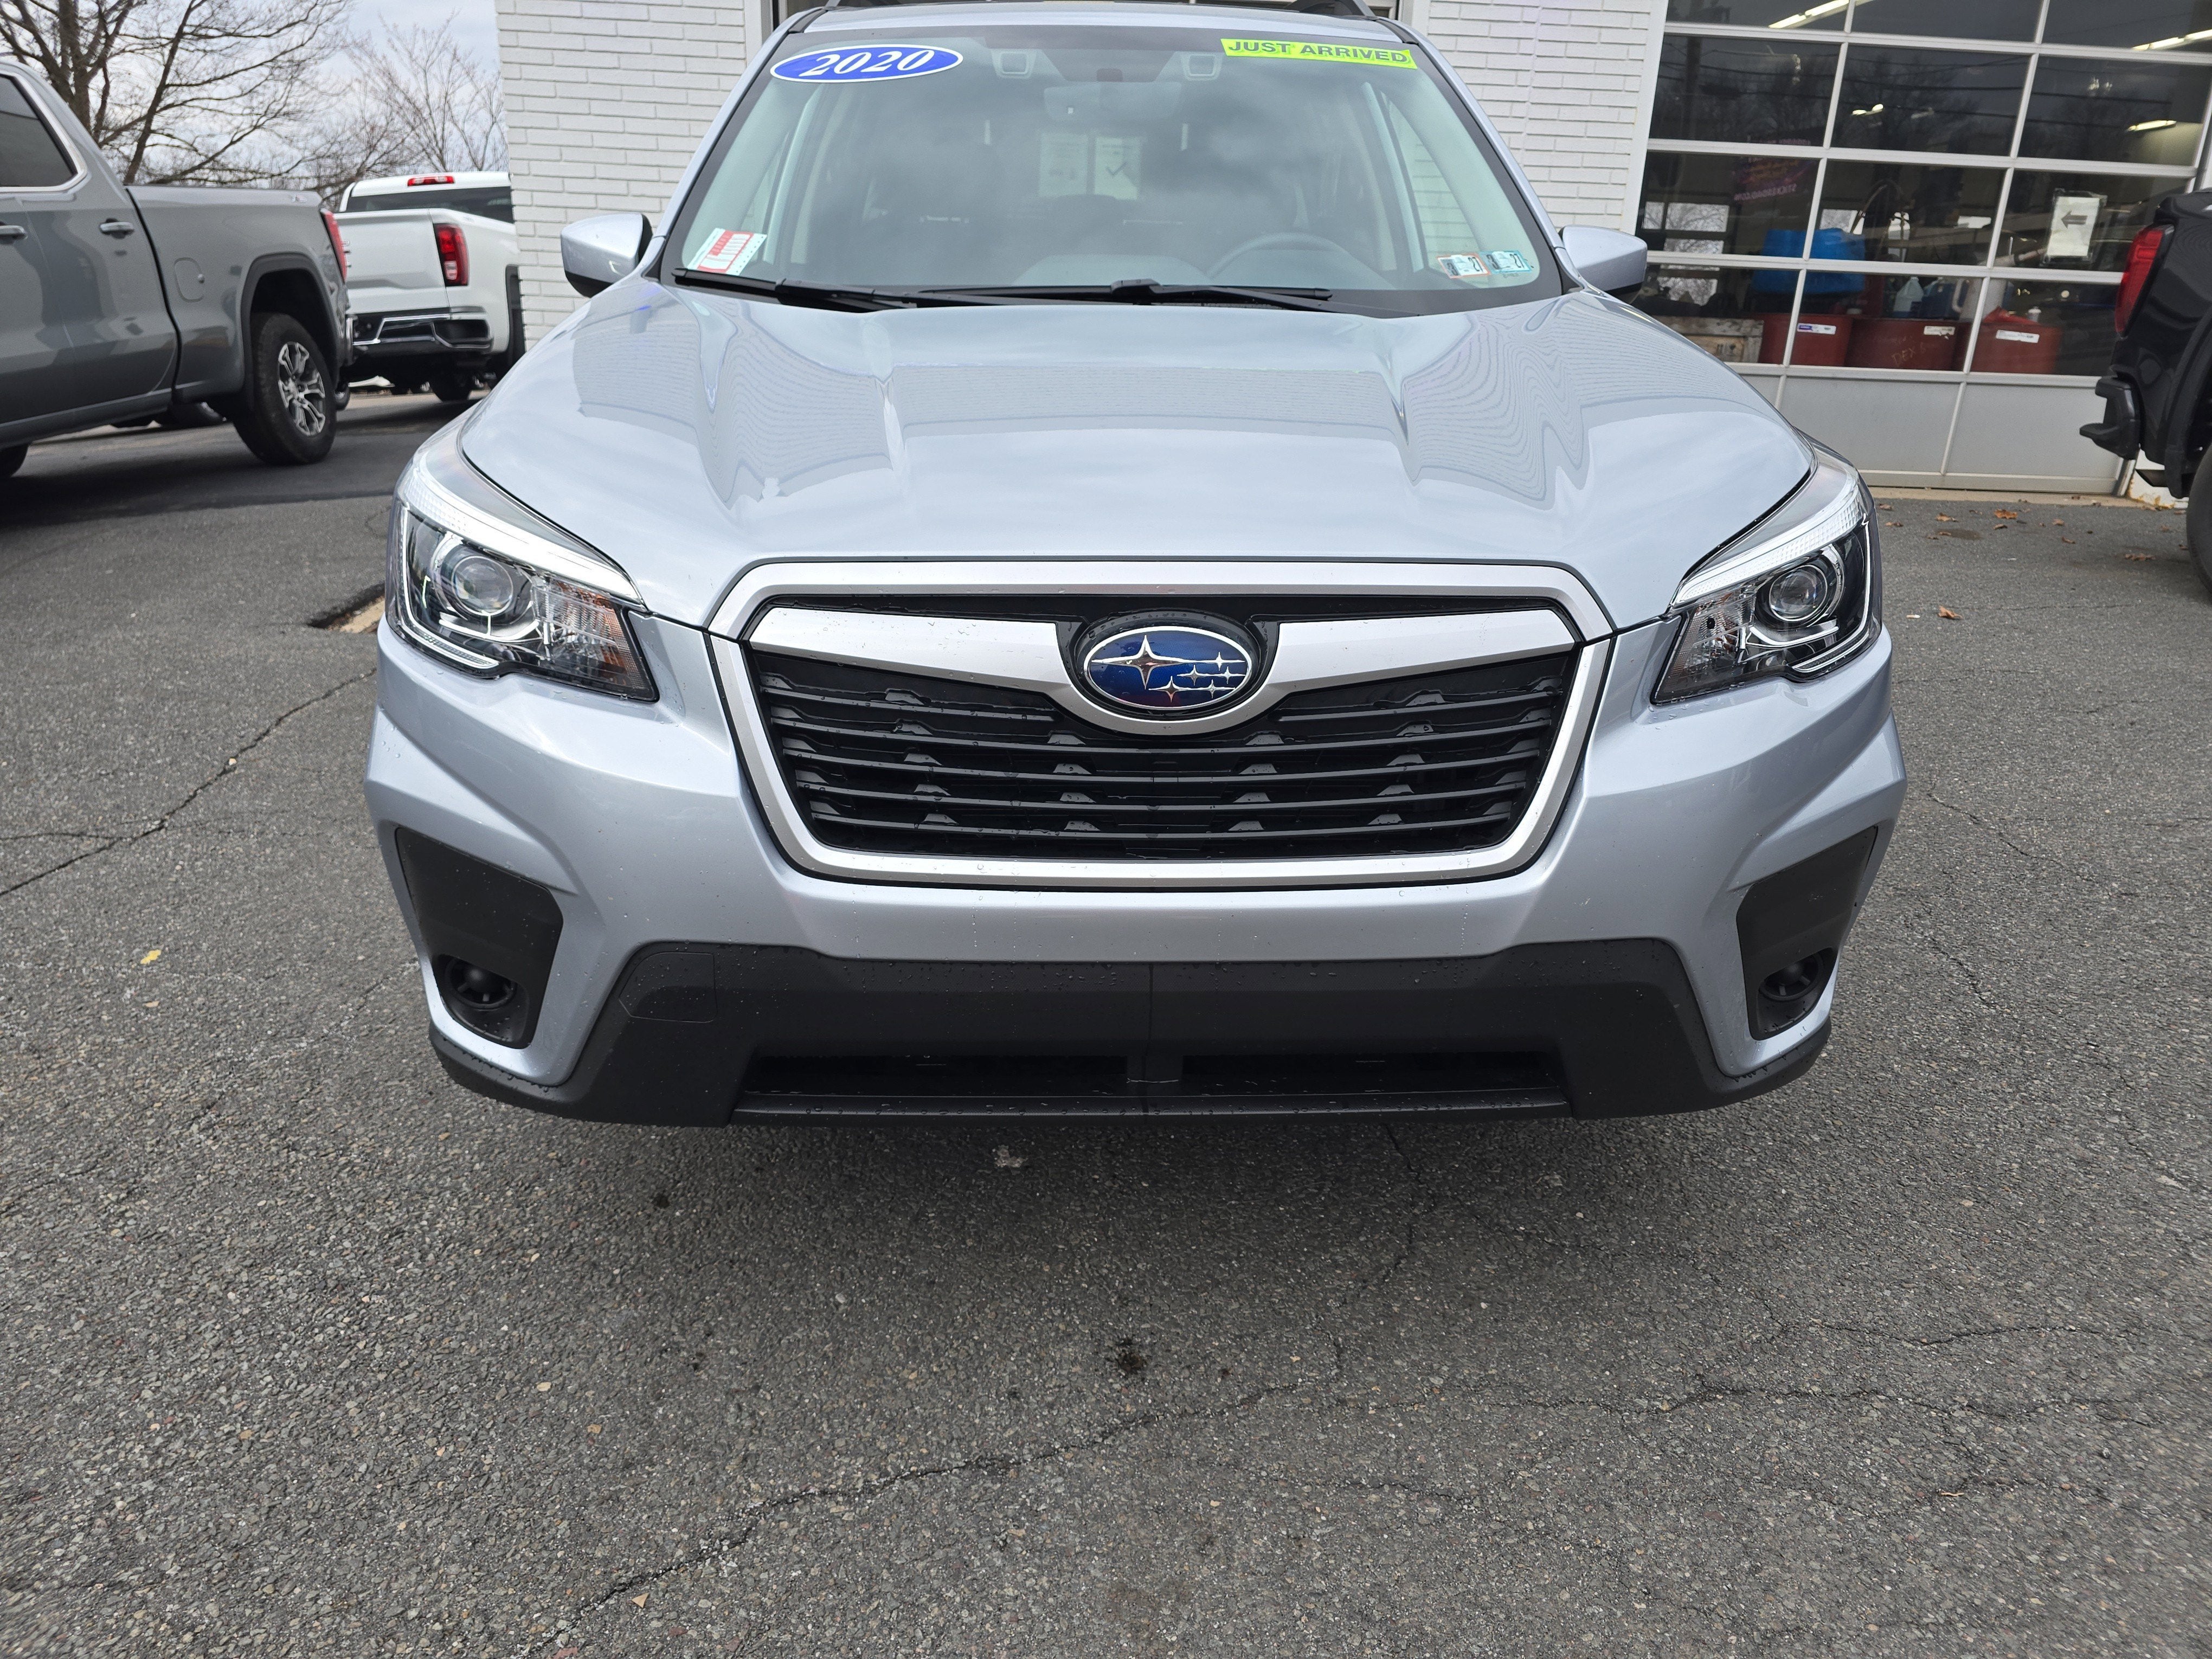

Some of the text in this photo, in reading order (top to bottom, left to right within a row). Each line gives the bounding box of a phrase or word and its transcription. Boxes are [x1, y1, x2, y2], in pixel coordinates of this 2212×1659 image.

[798, 49, 935, 77] 2020
[1228, 41, 1407, 62] JUST ARRIVED
